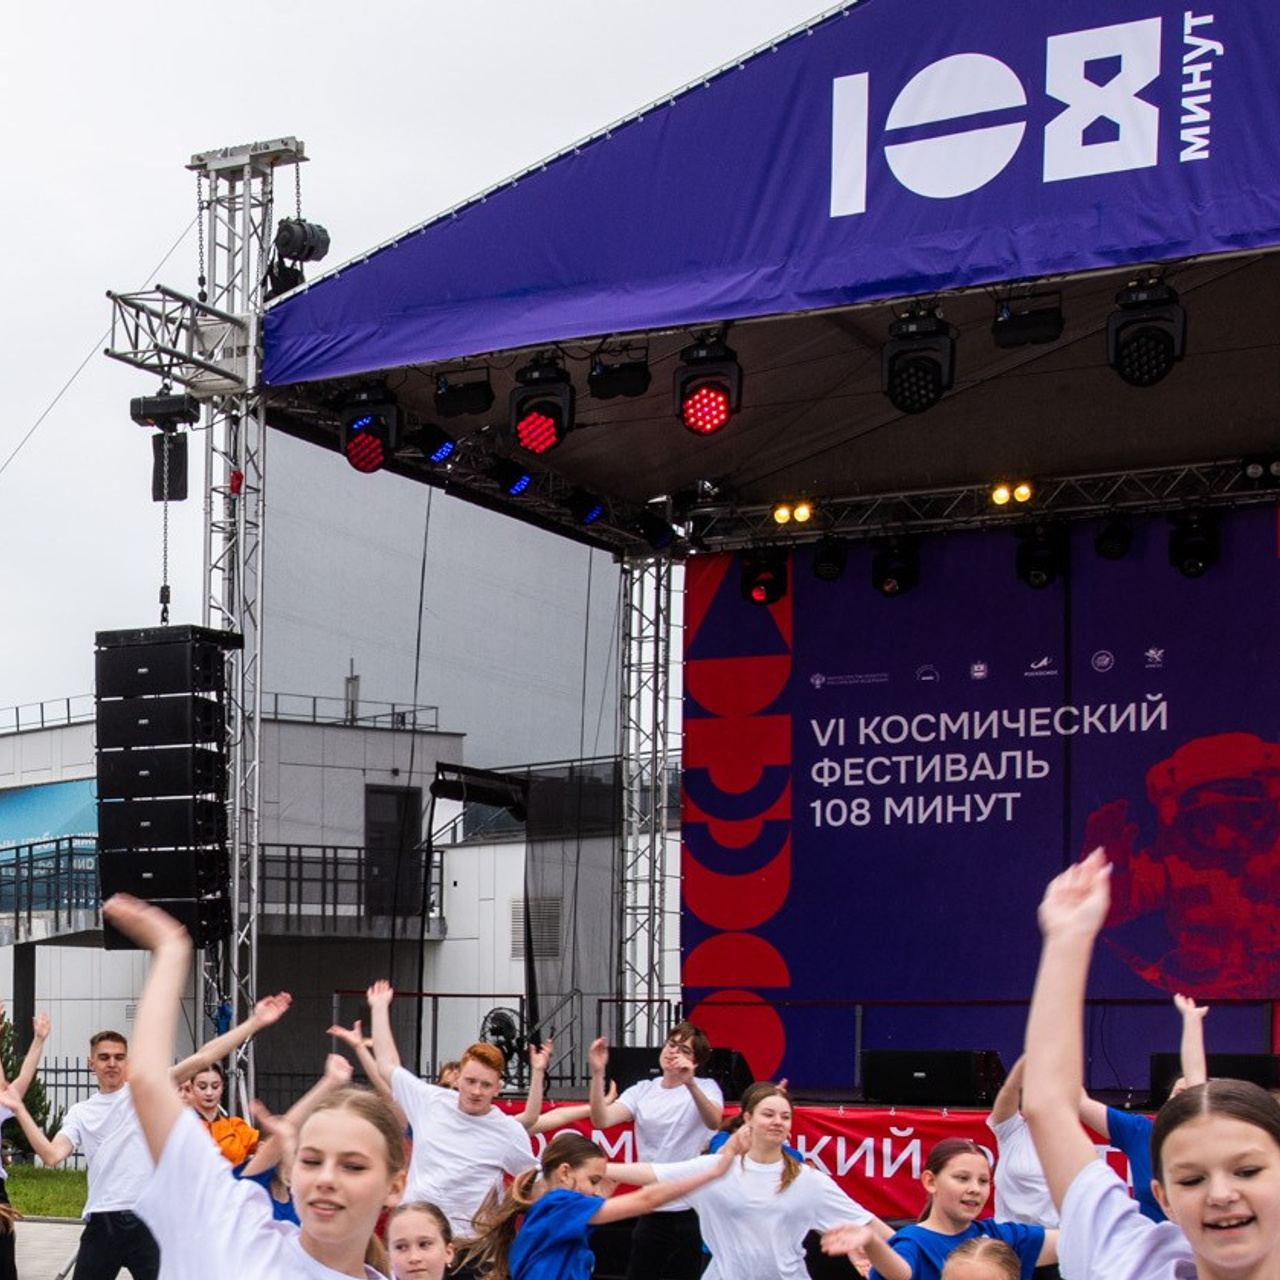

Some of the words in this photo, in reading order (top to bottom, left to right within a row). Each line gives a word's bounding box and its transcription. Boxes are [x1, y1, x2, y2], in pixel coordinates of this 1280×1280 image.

[1179, 10, 1225, 163] МИНУТ
[829, 16, 1163, 218] 108
[810, 717, 846, 747] VI
[859, 692, 1168, 746] КОСМИЧЕСКИЙ
[810, 750, 1050, 787] ФЕСТИВАЛЬ
[810, 797, 872, 827] 108
[884, 792, 1022, 826] МИНУТ
